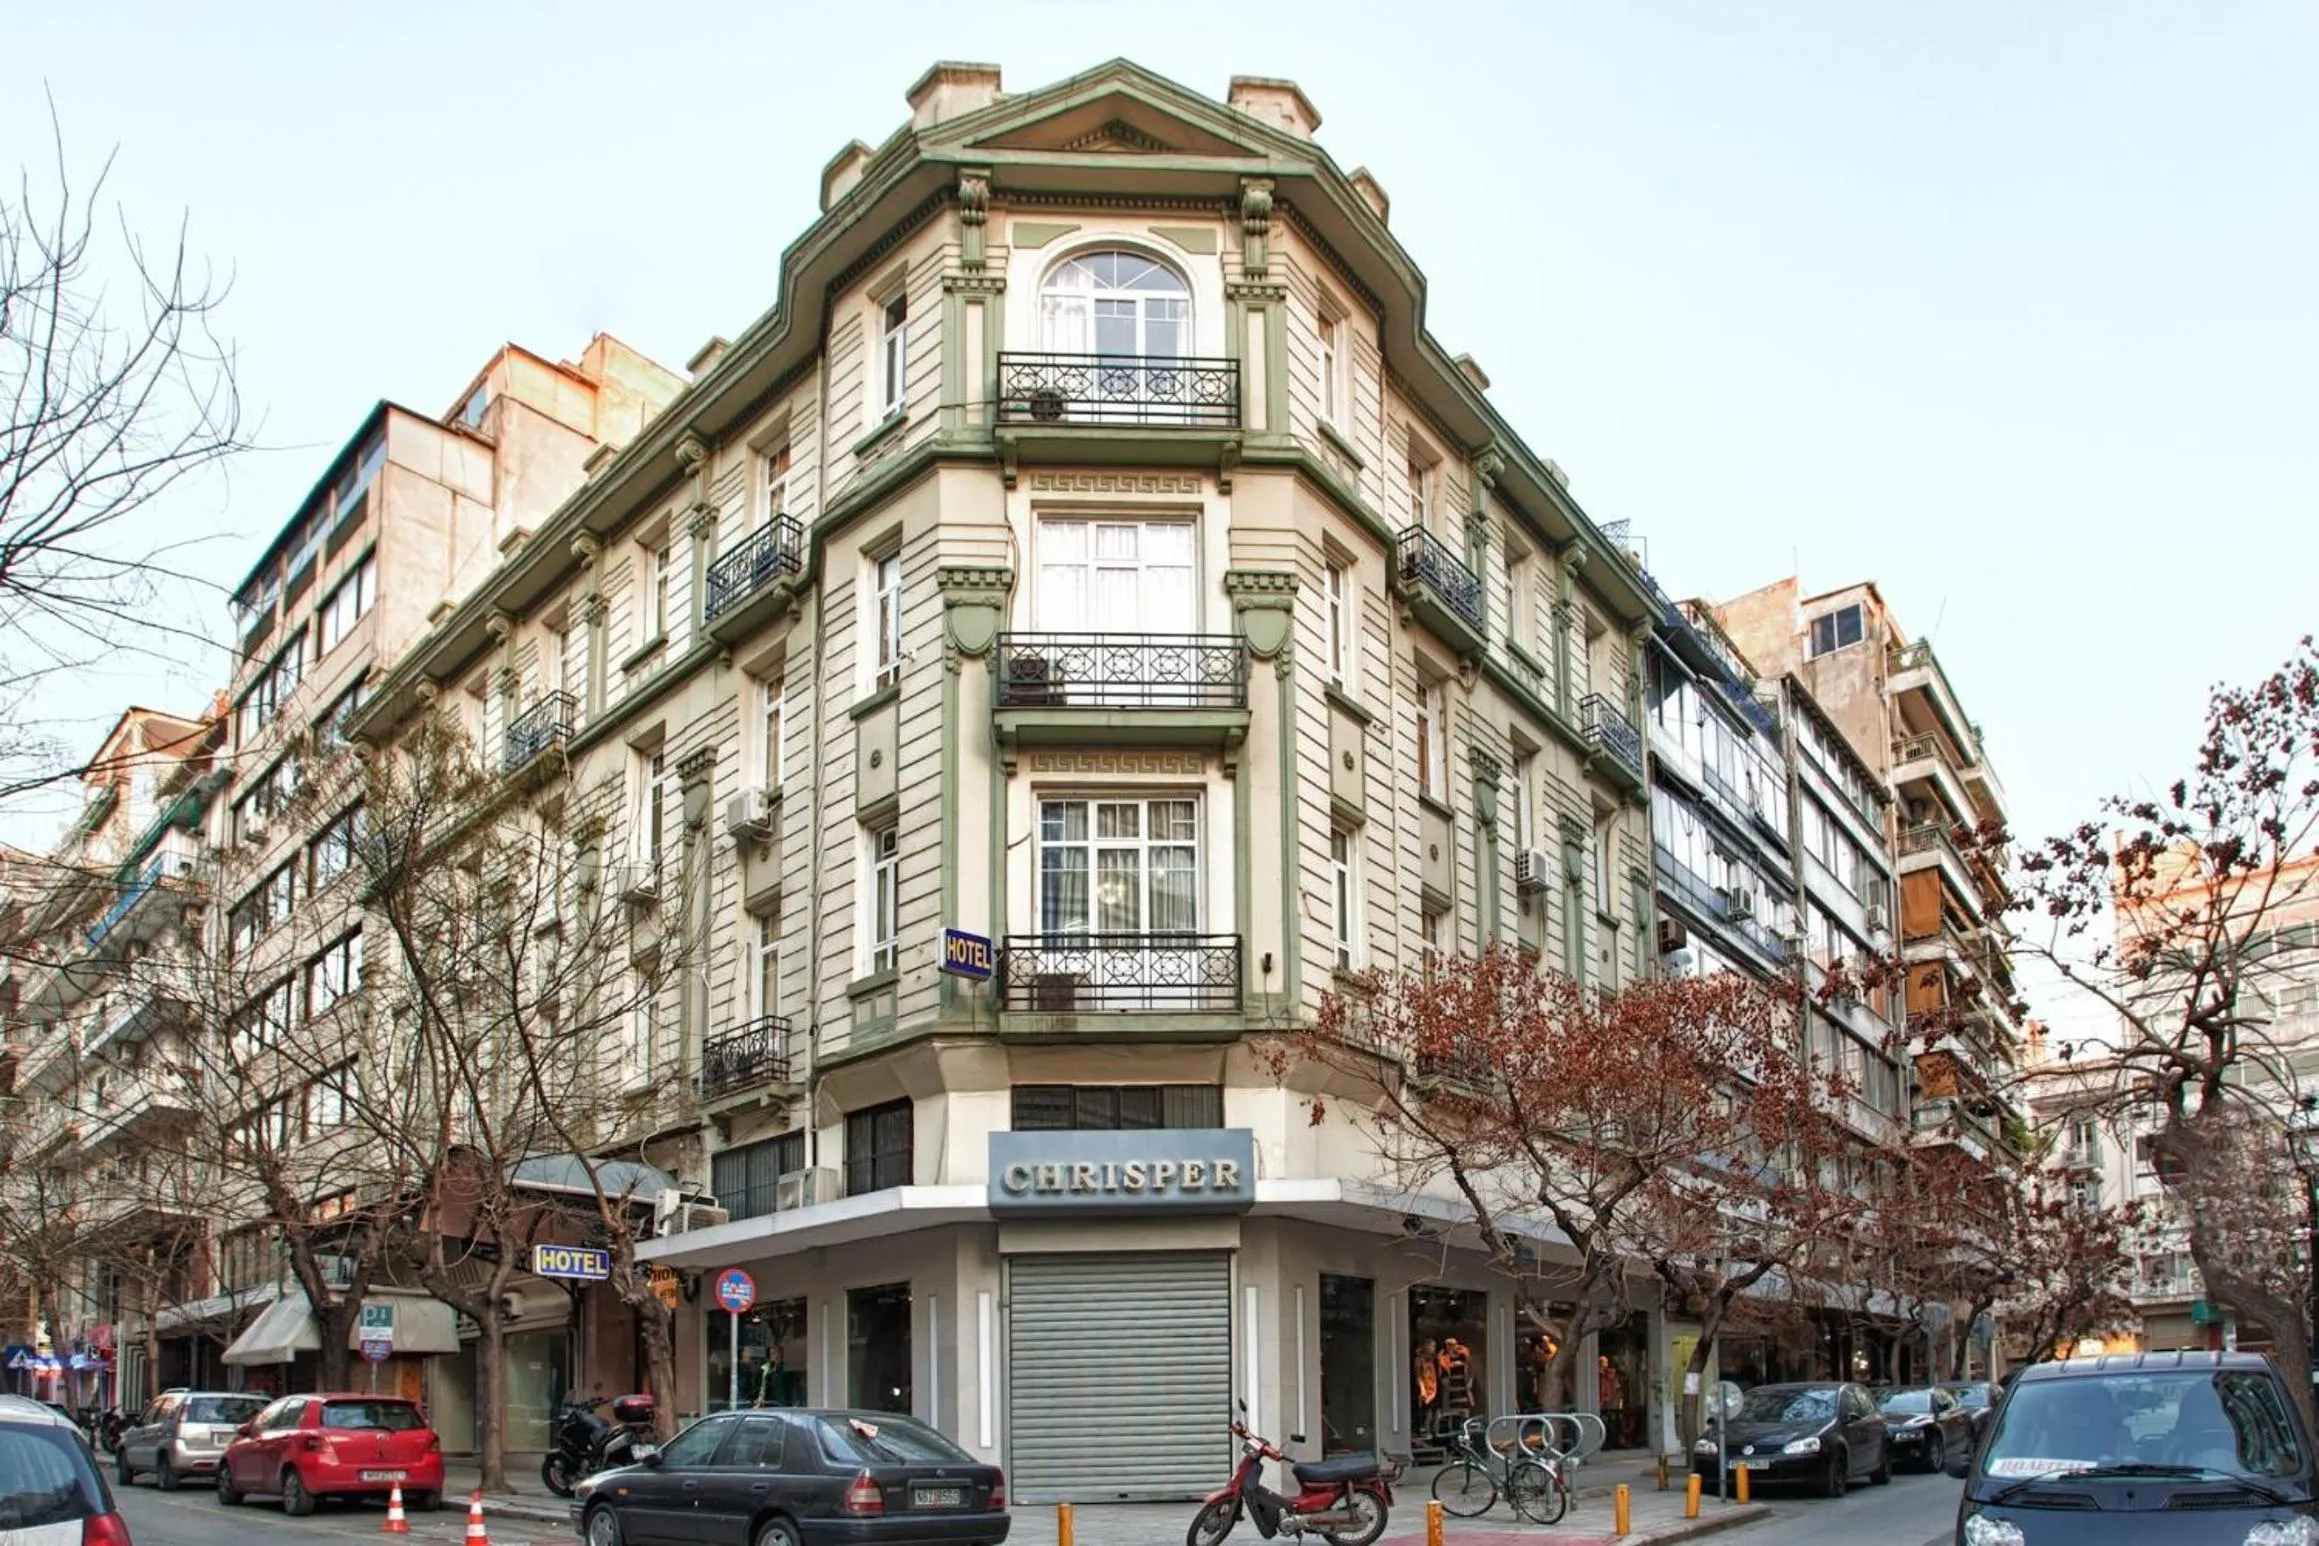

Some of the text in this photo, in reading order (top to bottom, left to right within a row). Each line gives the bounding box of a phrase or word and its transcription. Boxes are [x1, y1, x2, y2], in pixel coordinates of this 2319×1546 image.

[947, 935, 991, 969] HOTEL
[1003, 1159, 1240, 1193] CHRISPER
[541, 1250, 607, 1274] HOTEL
